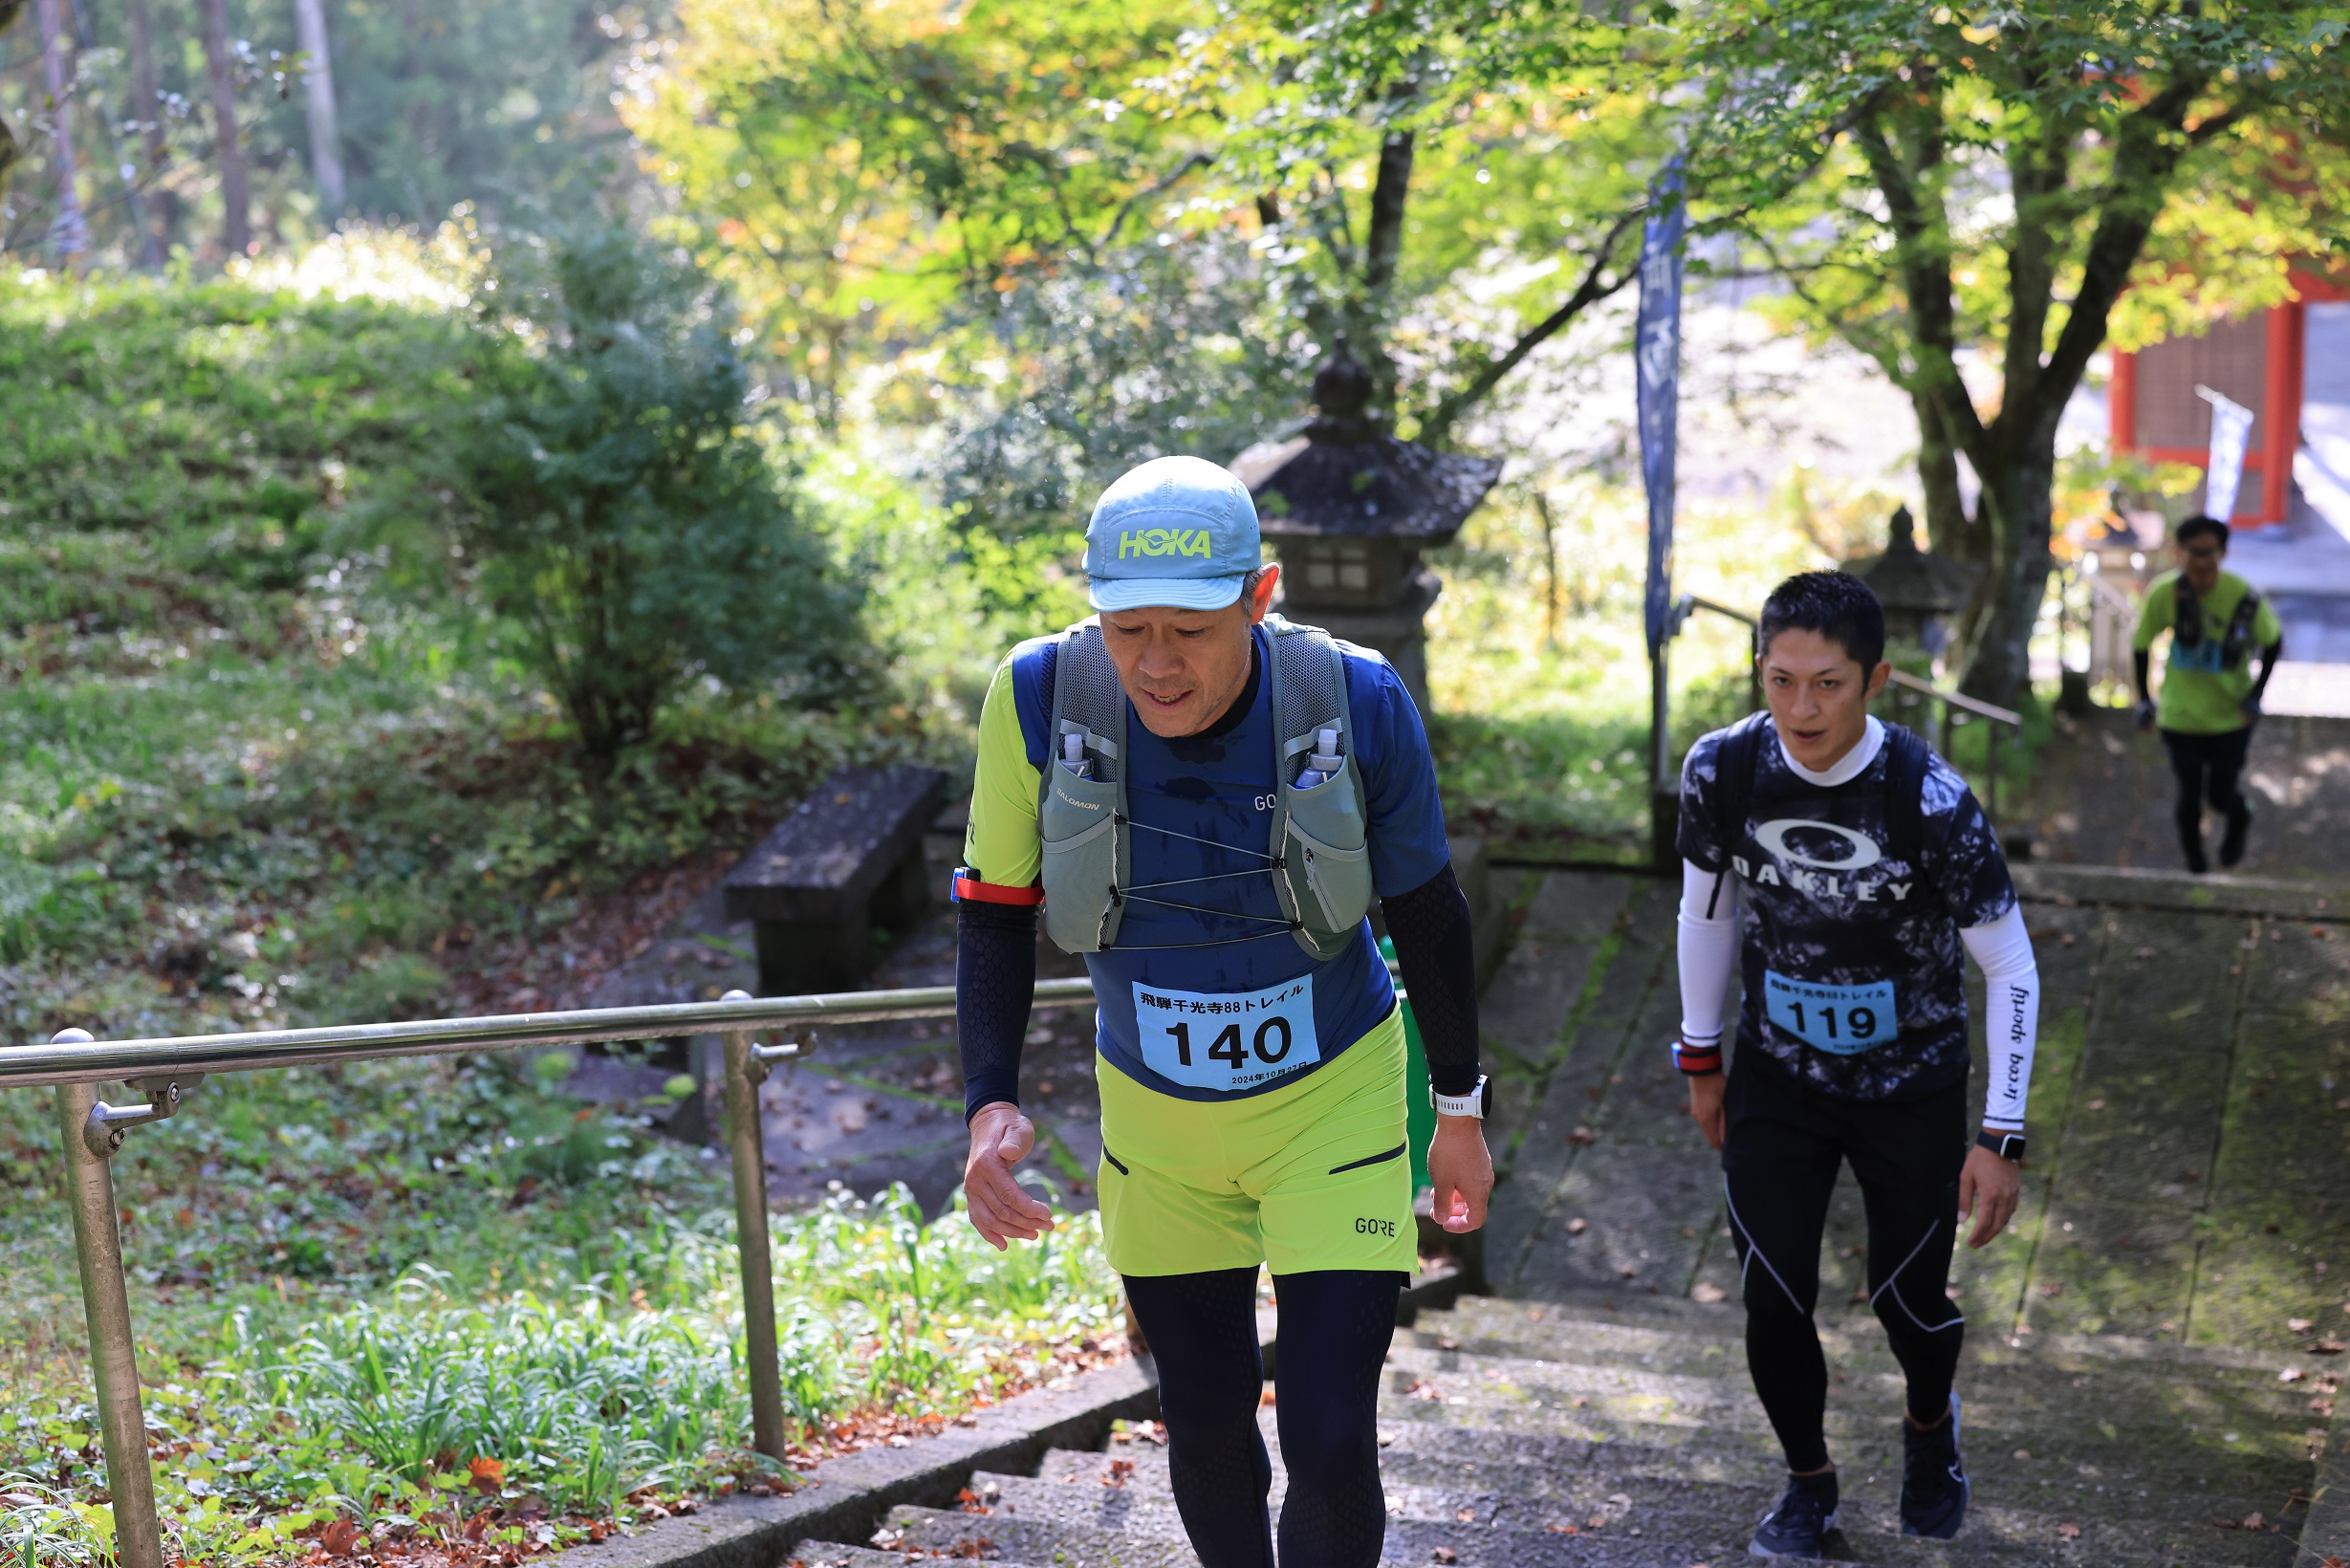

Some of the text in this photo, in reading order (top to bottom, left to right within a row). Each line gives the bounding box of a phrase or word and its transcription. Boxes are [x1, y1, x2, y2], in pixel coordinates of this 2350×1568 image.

[1118, 528, 1211, 559] HOKA
[1056, 787, 1100, 811] SALOMON
[1731, 855, 1913, 903] OAKLEY
[1141, 985, 1304, 1015] 飛騨千光寺88トレイル
[2011, 983, 2030, 1044] sportif
[1787, 1001, 1877, 1039] 119
[1165, 1016, 1292, 1070] 140
[2008, 1053, 2025, 1082] coq
[1355, 1217, 1396, 1238] GORE
